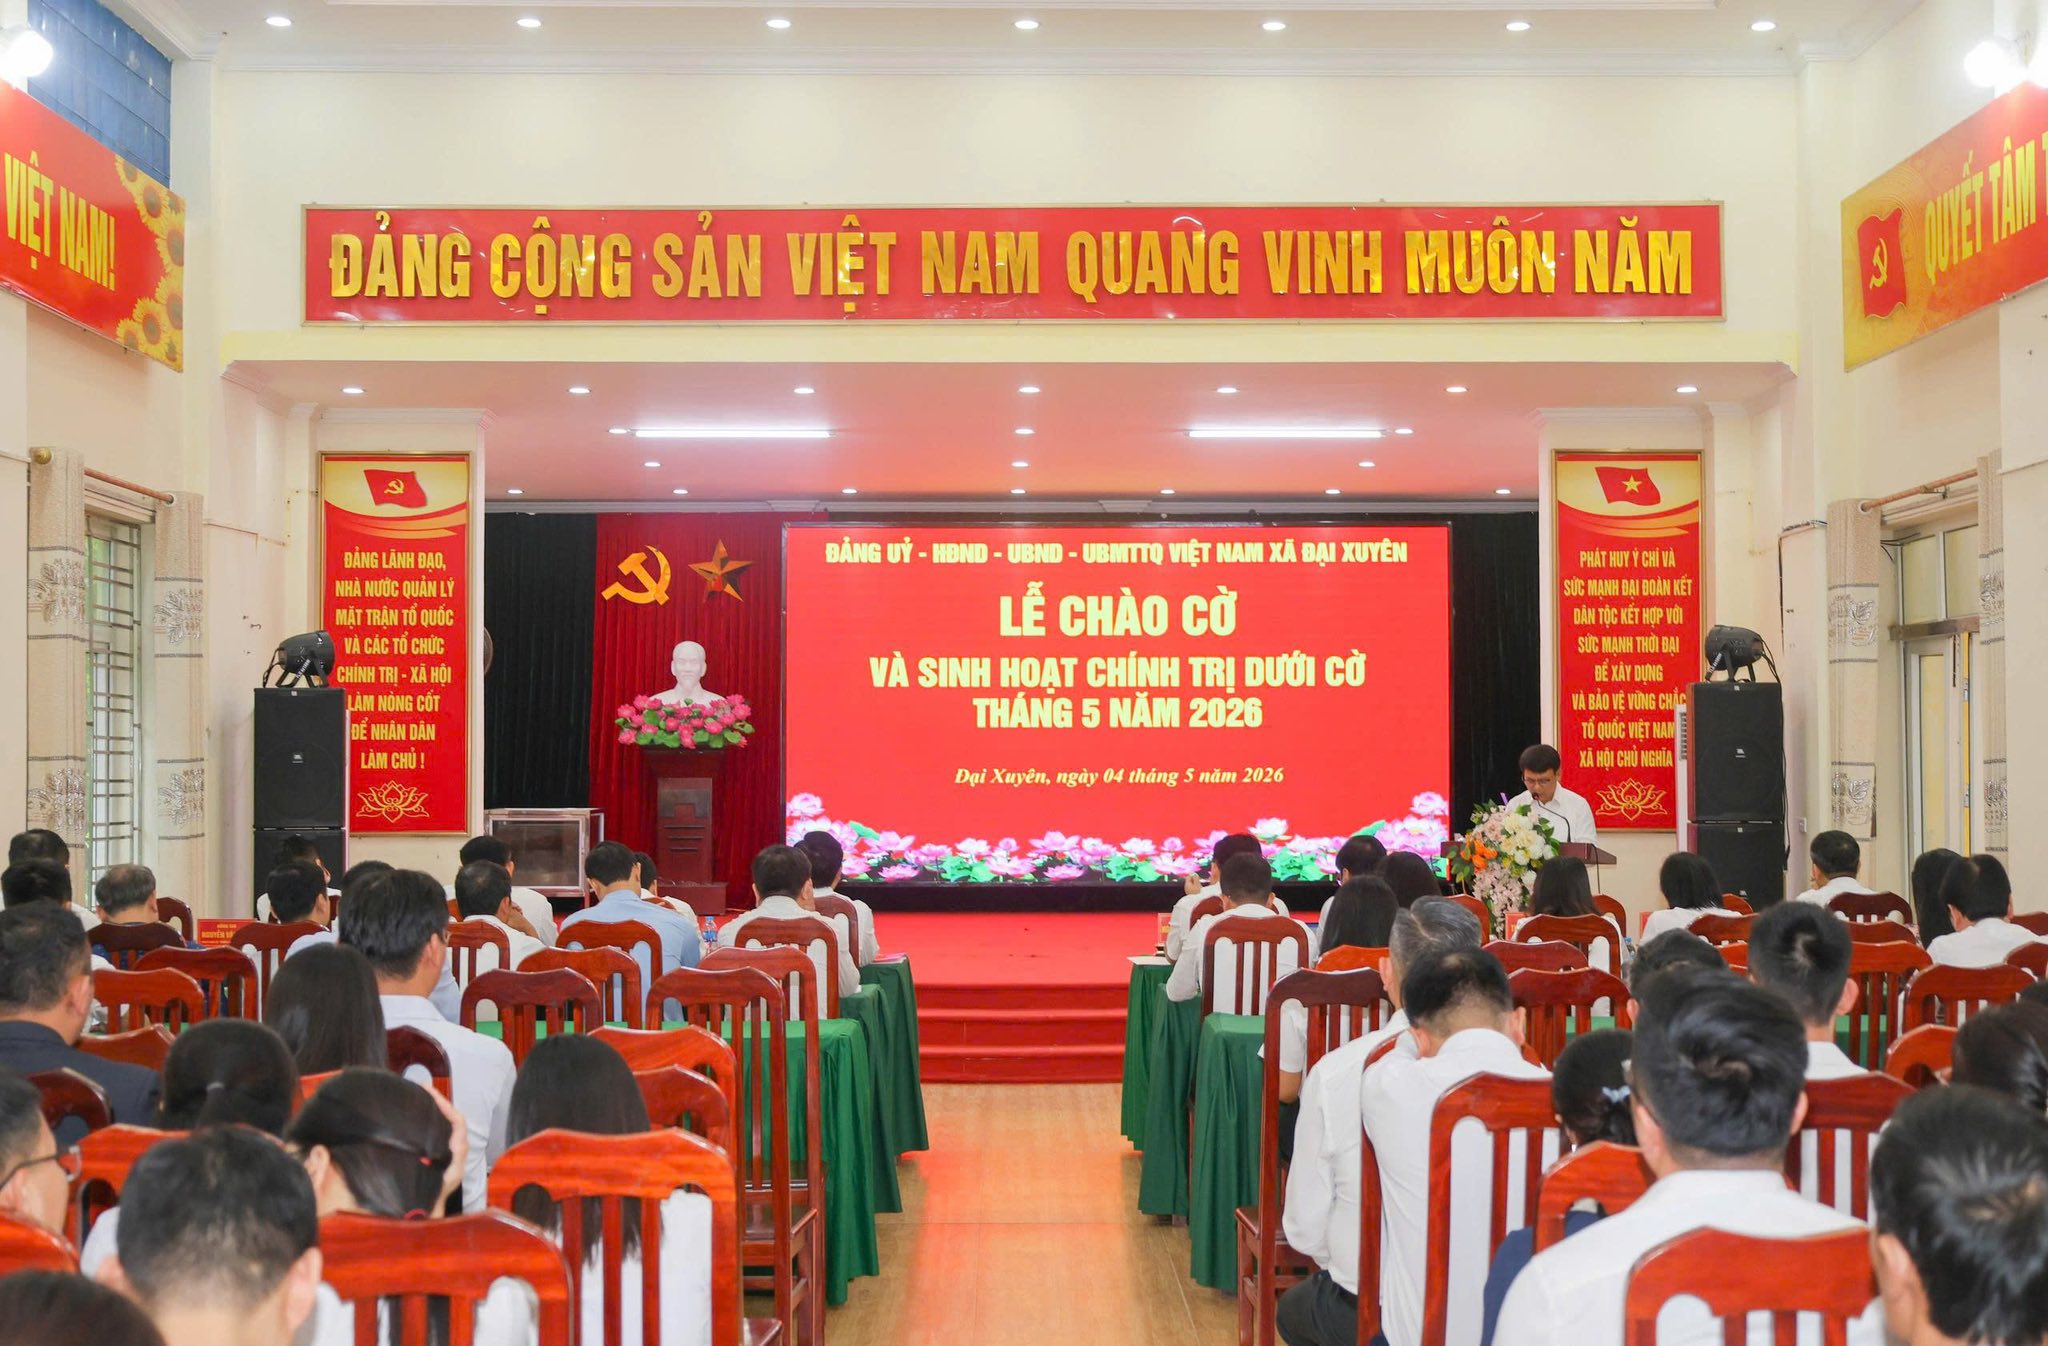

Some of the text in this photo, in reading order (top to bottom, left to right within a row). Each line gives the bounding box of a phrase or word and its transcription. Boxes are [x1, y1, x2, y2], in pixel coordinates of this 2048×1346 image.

[4, 150, 115, 291] VIỆT NAM!
[1925, 150, 1984, 286] QUYẾT
[1989, 136, 2036, 244] TÂM
[329, 210, 1692, 315] ĐẢNG CỘNG SẢN VIỆT NAM QUANG VINH MUÔN NĂM
[344, 546, 447, 572] ĐẢNG LÃNH ĐẠO,
[825, 536, 881, 563] ĐẢNG
[887, 536, 914, 563] UỶ
[932, 543, 988, 563] HĐND
[1008, 543, 1063, 563] UBND
[1082, 543, 1163, 566] UBMTTQ
[1168, 539, 1212, 567] VIỆT
[1217, 542, 1264, 563] NAM
[1269, 538, 1297, 563] XÃ
[1301, 542, 1337, 567] ĐẠI
[1341, 538, 1408, 563] XUYÊN
[1580, 547, 1676, 568] PHÁT HUY Ý CHÍ VÀ
[335, 575, 455, 599] NHÀ NƯỚC QUẢN LÝ
[1564, 574, 1692, 600] SỨC MẠNH ĐẠI ĐOÀN KẾT
[335, 603, 454, 629] MẶT TRẬN TỔ QUỐC
[1000, 581, 1238, 637] LỄ CHÀO CỜ
[1573, 602, 1683, 629] DÂN TỘC KẾT HỢP VỚI
[344, 631, 445, 655] VÀ CÁC TỔ CHỨC
[1578, 633, 1680, 657] SỨC MẠNH THỜI ĐẠI
[337, 662, 376, 683] CHÍNH
[379, 666, 398, 687] TRỊ
[410, 663, 428, 683] XÃ
[430, 663, 452, 687] HỘI
[869, 648, 1367, 694] VÀ SINH HOẠT CHÍNH TRỊ DƯỚI CỜ
[1595, 658, 1664, 686] ĐỂ XÂY DỰNG
[347, 689, 441, 711] LÀM NÒNG CỐT
[972, 691, 1263, 728] THÁNG 5 NĂM 2026
[1572, 690, 1586, 710] VÀ
[1588, 688, 1610, 710] BẢO
[1612, 690, 1626, 714] VỆ
[1628, 690, 1656, 710] VỮNG
[351, 717, 436, 740] ĐỂ NHÂN DÂN
[1582, 716, 1595, 739] TỔ
[1597, 716, 1626, 741] QUỐC
[1628, 719, 1650, 743] VIỆT
[361, 749, 388, 769] LÀM
[391, 747, 417, 769] CHỦ
[1579, 745, 1674, 772] XÃ HỘI CHỦ NGHĨA
[954, 767, 1284, 788] Đại Xuyên, ngày 04 tháng 5 năm 2026
